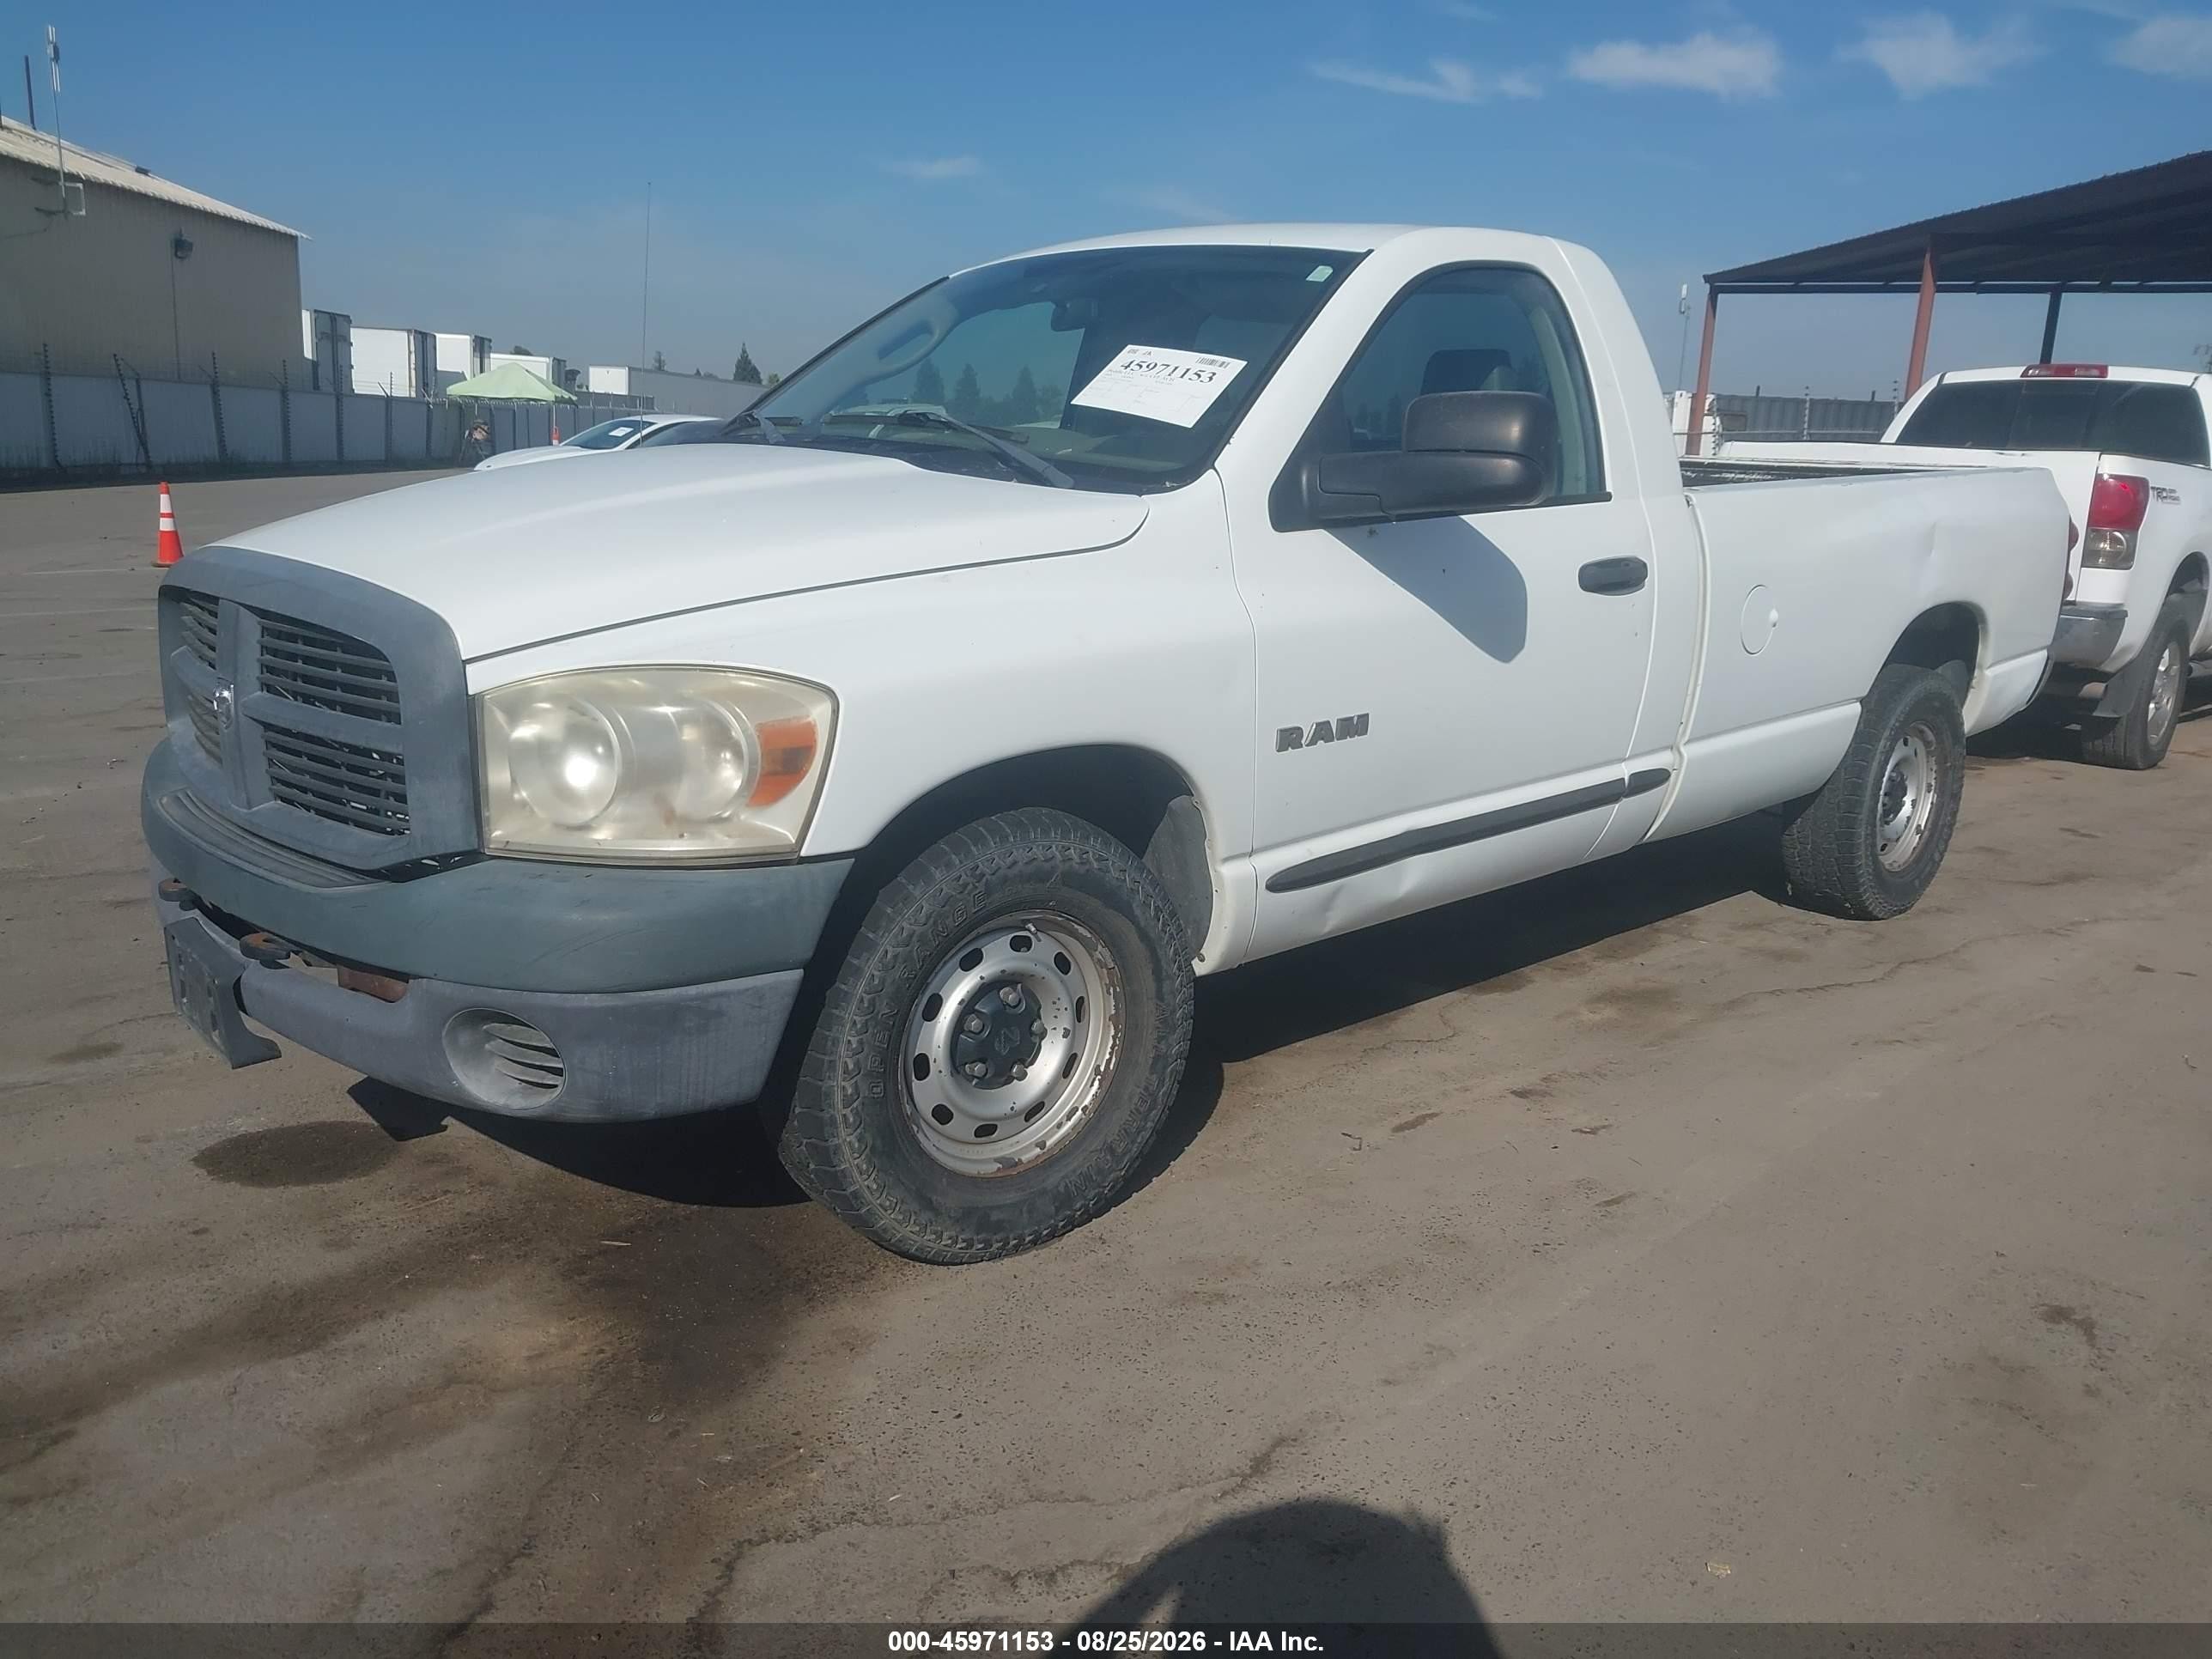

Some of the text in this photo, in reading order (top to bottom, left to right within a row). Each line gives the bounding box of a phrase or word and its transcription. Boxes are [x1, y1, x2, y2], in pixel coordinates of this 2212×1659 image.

[1120, 358, 1218, 384] 45971153
[1275, 713, 1370, 752] RAM
[868, 890, 988, 1098] OPEN RANGE
